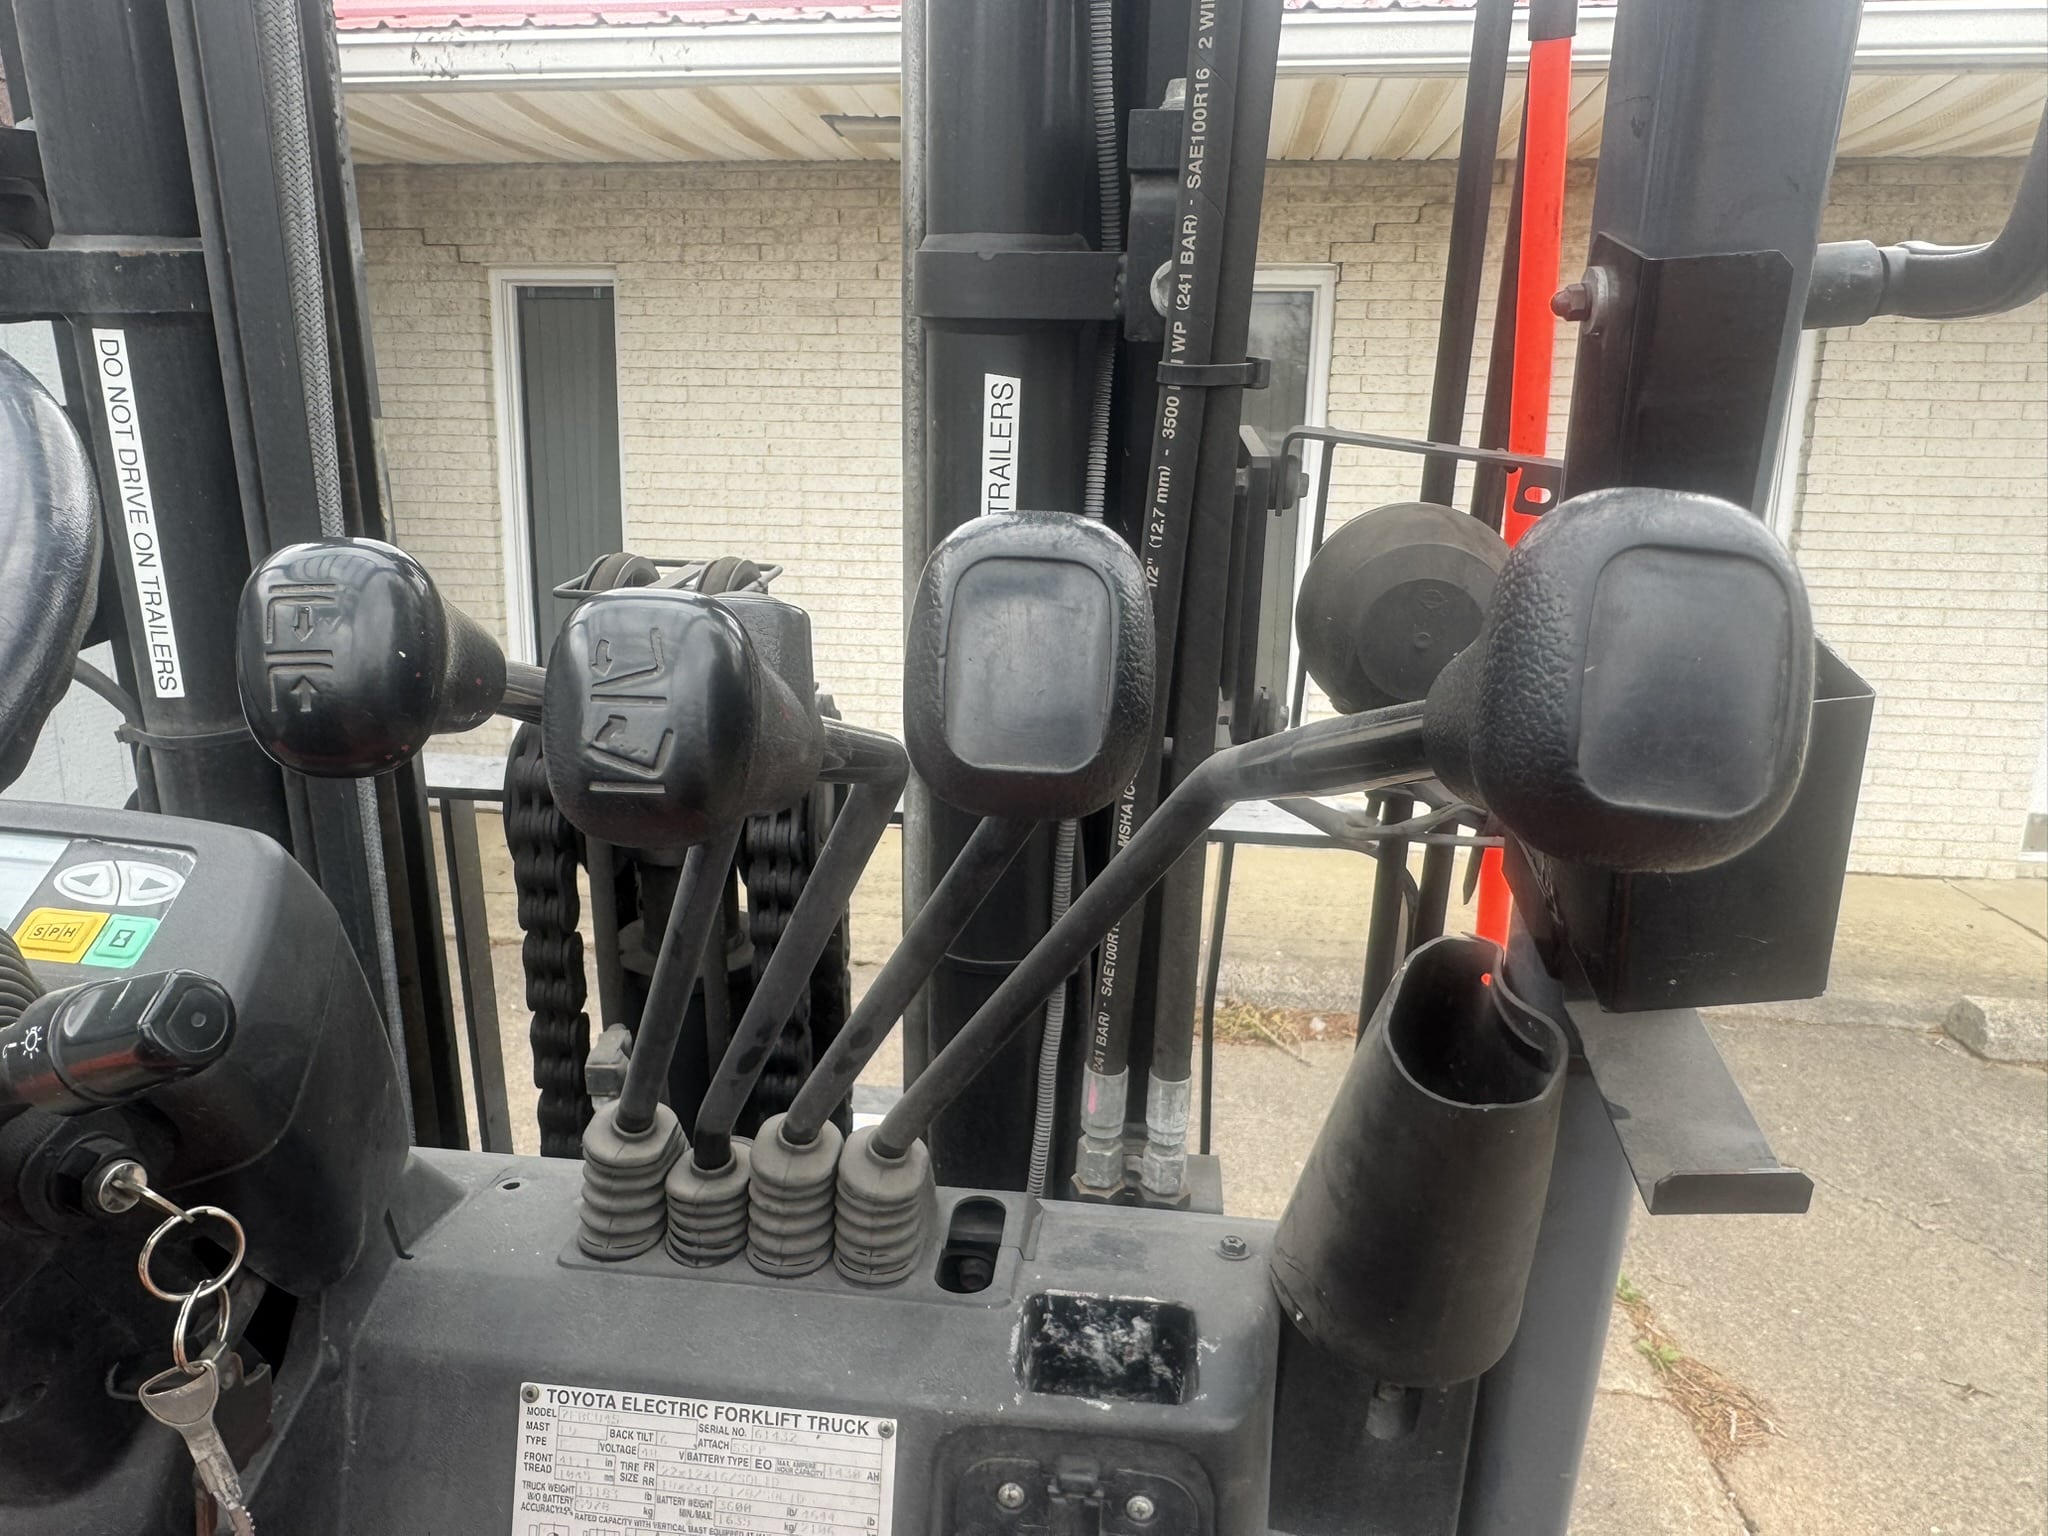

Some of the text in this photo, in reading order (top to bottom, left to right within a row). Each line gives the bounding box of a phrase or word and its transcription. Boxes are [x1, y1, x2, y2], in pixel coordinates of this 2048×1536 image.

[1198, 0, 1216, 31] WI
[1198, 36, 1213, 49] 2
[1186, 67, 1211, 190] SAE100R16
[1180, 214, 1198, 266] BAR)
[1175, 273, 1193, 313] (241
[1171, 321, 1188, 353] WP
[1162, 395, 1180, 440] 3500
[988, 382, 1014, 516] TRAILERS
[1155, 465, 1172, 504] mm)
[98, 338, 178, 692] DO NOT DRIVE ON TRAILERS
[1149, 506, 1167, 549] (12.7
[1117, 803, 1135, 848] MSHA
[1101, 920, 1121, 997] SAE100R1
[1096, 1011, 1111, 1047] BAR)
[526, 1406, 557, 1418] MODEL
[547, 1387, 870, 1436] TOYOTA ELECTRIC FORKLIFT TRUCK
[526, 1421, 550, 1432] MAST
[698, 1423, 730, 1436] SERIAL
[732, 1426, 747, 1438] NO.
[526, 1435, 547, 1446] TYPE
[609, 1428, 634, 1440] BACK
[637, 1431, 654, 1442] TILT
[600, 1443, 637, 1455] VOLTAGE
[697, 1438, 729, 1451] ATTACH
[524, 1452, 553, 1463] FRONT
[686, 1451, 773, 1470] BATTERY TYPE EO
[524, 1463, 552, 1474] TREAD
[620, 1461, 640, 1472] TIRE
[643, 1461, 656, 1472] FR
[620, 1472, 640, 1484] SIZE
[642, 1476, 655, 1487] RR
[867, 1472, 880, 1482] AH
[522, 1481, 546, 1491] TRUCK
[547, 1483, 576, 1494] WEIGHT
[542, 1494, 574, 1505] BATTERY
[656, 1494, 686, 1507] BATTERY
[688, 1498, 713, 1510] WEIGHT
[574, 1512, 597, 1523] RATED
[599, 1515, 633, 1527] CAPACITY
